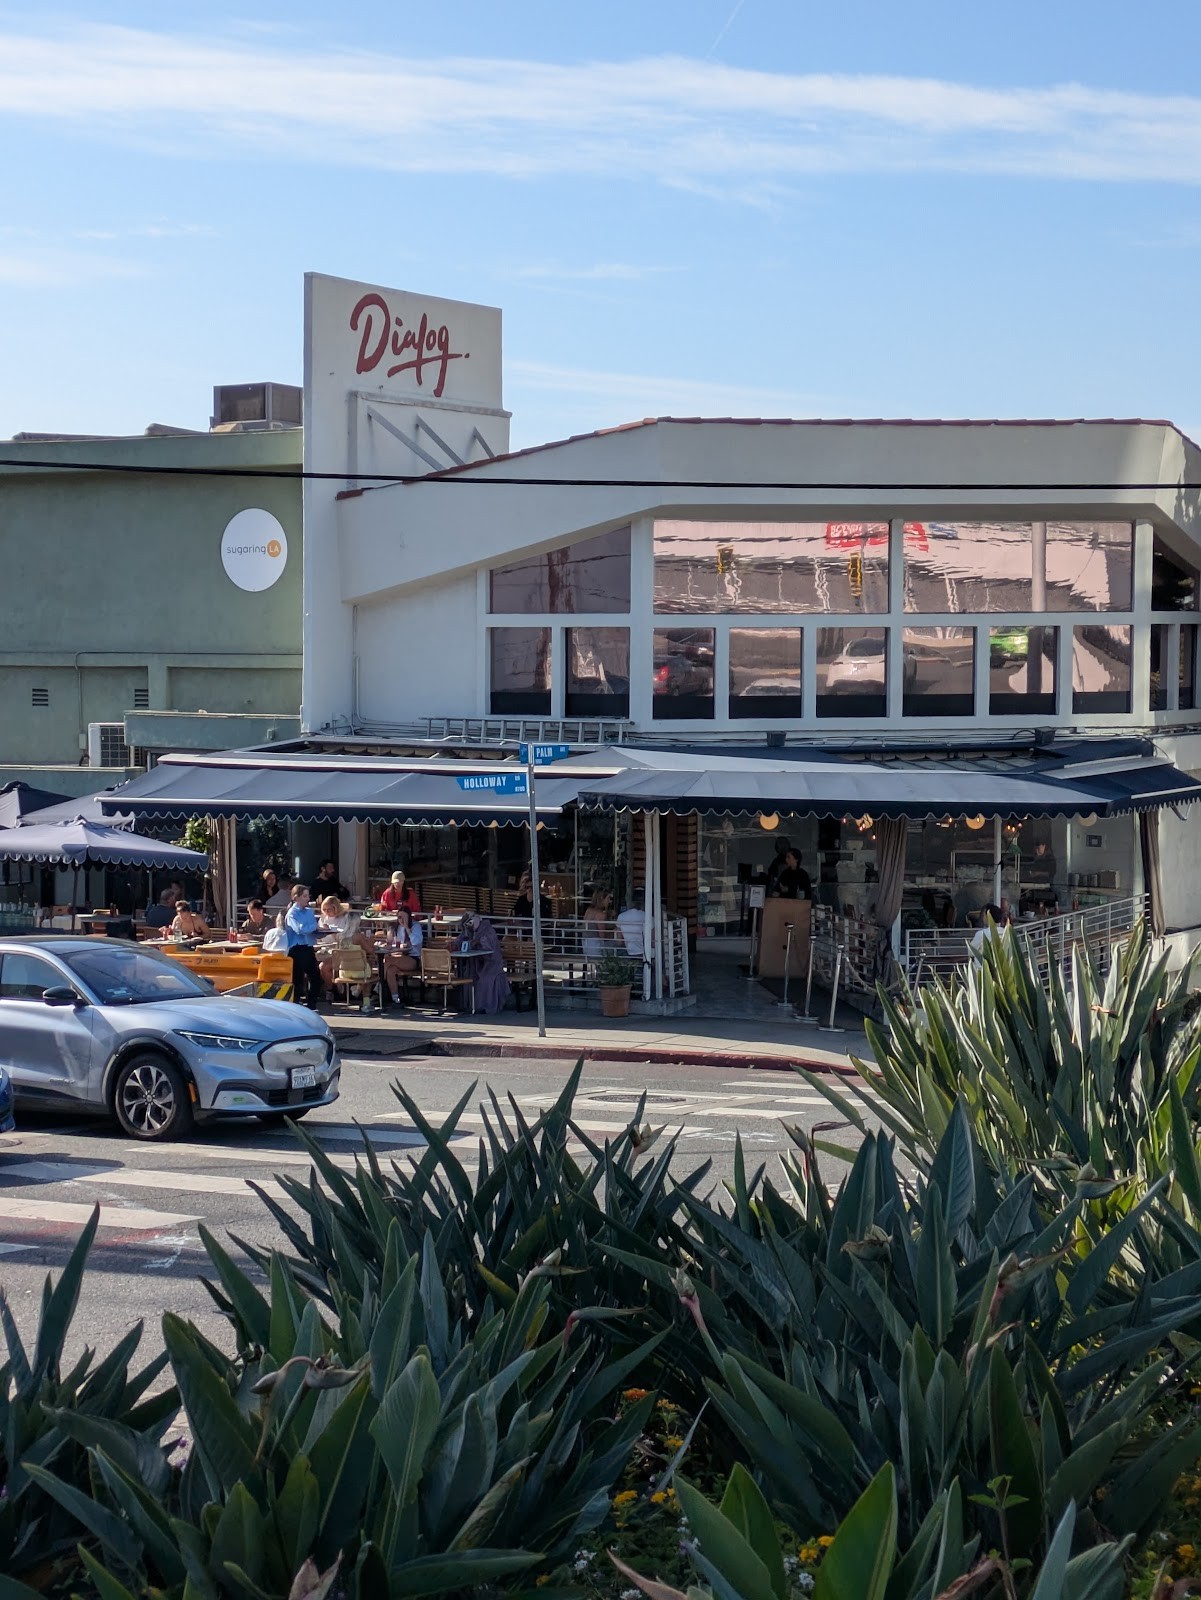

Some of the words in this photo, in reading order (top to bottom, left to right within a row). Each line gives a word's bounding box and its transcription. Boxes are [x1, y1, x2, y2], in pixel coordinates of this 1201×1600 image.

[226, 545, 267, 555] sugaring
[536, 747, 553, 758] PALM
[464, 775, 507, 789] HOLLOWAY
